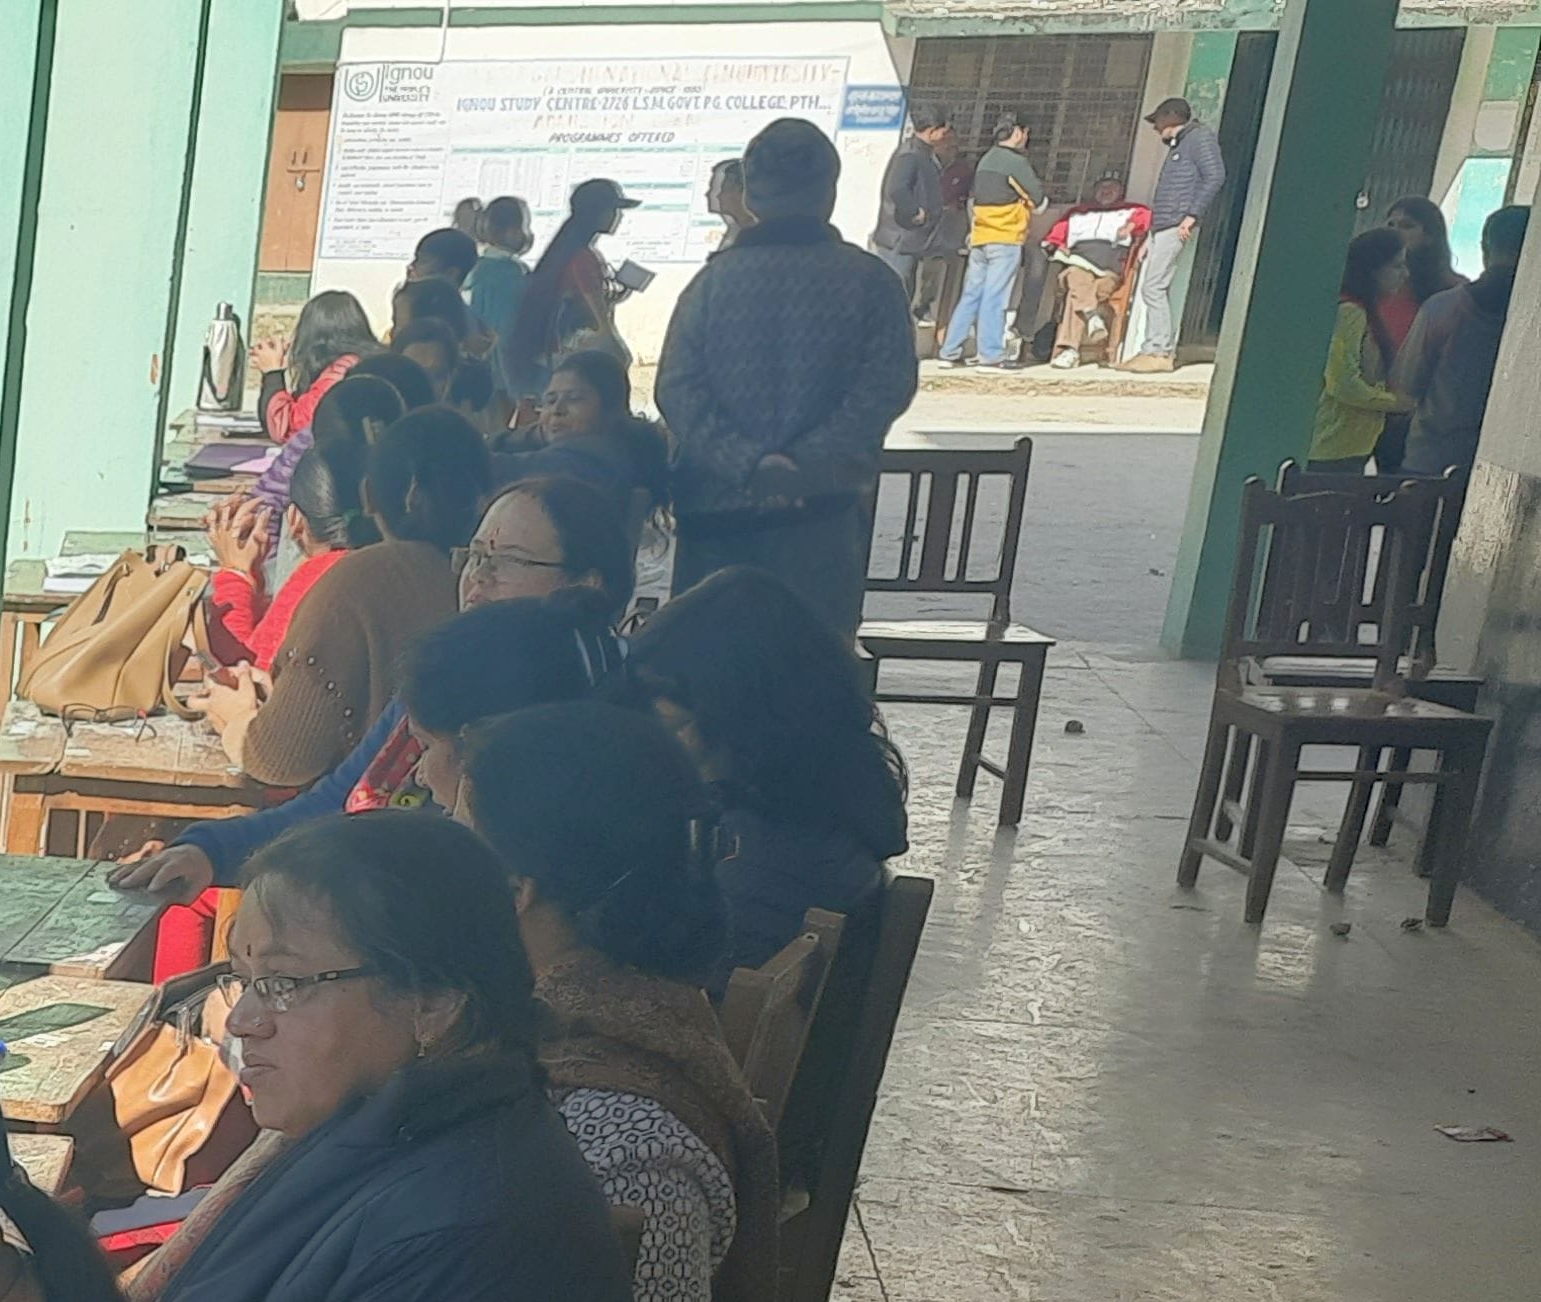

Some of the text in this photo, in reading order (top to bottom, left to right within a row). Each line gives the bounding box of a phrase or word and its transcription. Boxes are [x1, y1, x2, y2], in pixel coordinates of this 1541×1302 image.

[456, 96, 497, 112] IGNOU
[500, 96, 542, 112] STUDY
[627, 131, 675, 143] OFFERED
